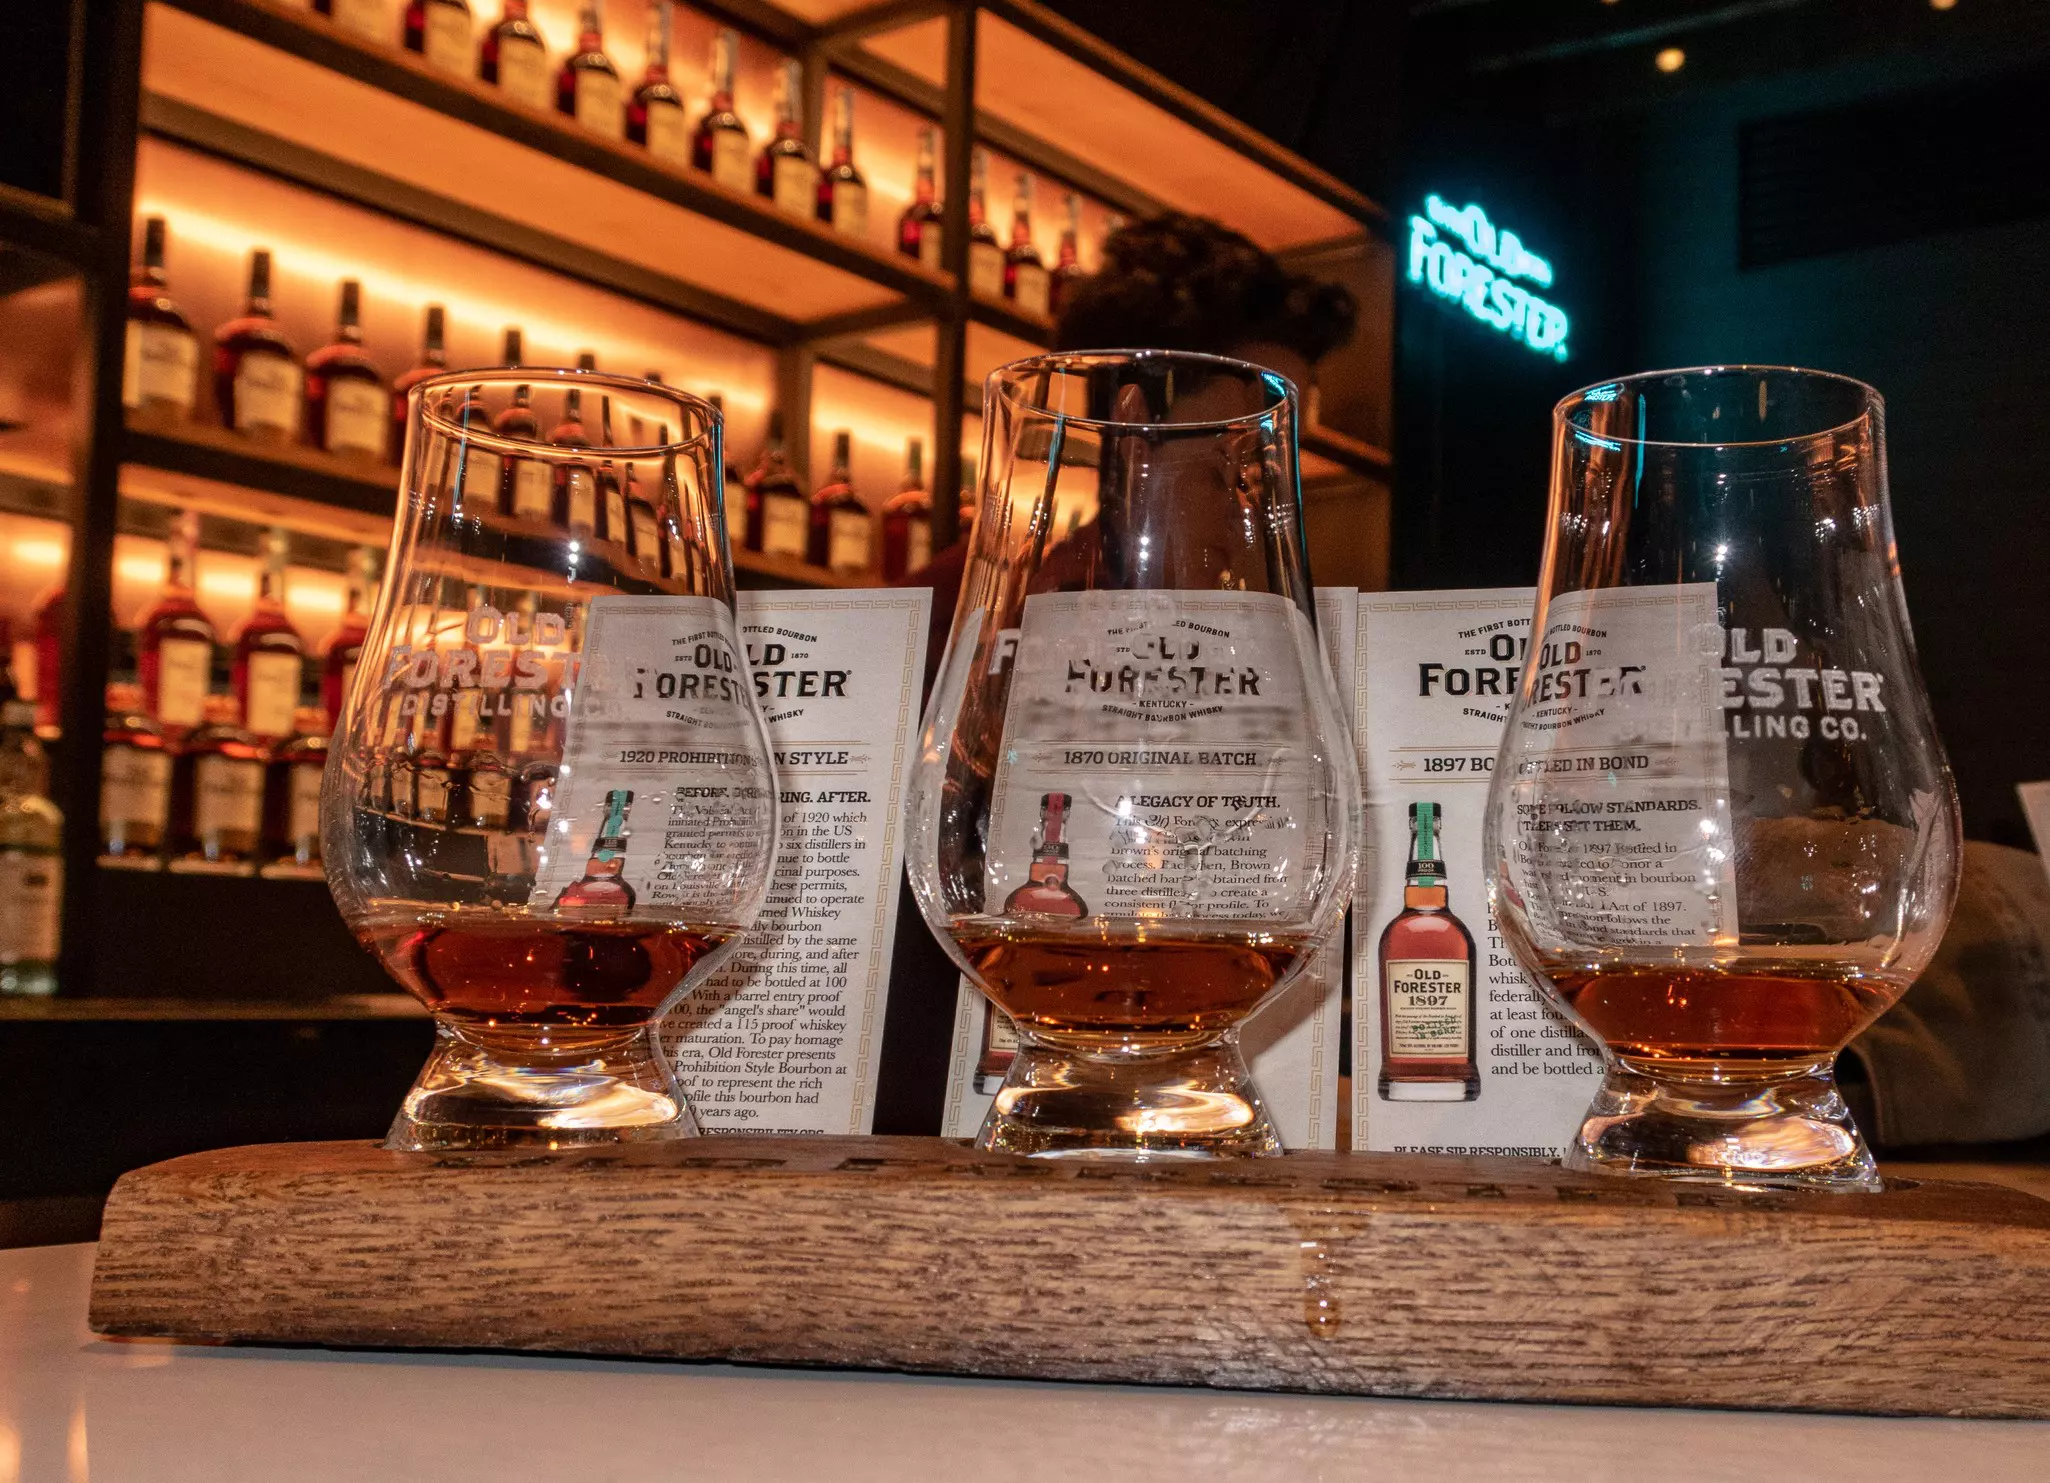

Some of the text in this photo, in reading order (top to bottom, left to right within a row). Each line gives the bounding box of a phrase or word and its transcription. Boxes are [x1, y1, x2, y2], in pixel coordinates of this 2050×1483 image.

[466, 606, 565, 646] OLD
[1188, 621, 1231, 638] BOURBON
[1458, 621, 1505, 640] THE FIRST
[1572, 625, 1608, 639] BOURBON
[776, 628, 818, 643] BOURBON
[694, 643, 733, 673] OLD
[748, 643, 809, 666] LD 1870
[1539, 641, 1581, 671] OLD
[381, 644, 582, 690] FOREST
[1418, 662, 1521, 697] FORE
[1138, 700, 1188, 709] KENTUCKY
[769, 709, 805, 723] WHISKY
[1102, 704, 1143, 721] STRAIGHT
[1189, 705, 1224, 719] WHISKY
[1733, 715, 1868, 741] LING CO.
[620, 751, 656, 764] 1920
[789, 751, 849, 765] STYLE
[1063, 751, 1257, 766] 1870 ORIGINAL BATCH
[1423, 757, 1466, 772] 1897
[1576, 755, 1649, 771] IN BOND
[817, 791, 872, 803] AFTER.
[1130, 795, 1193, 808] LEGACY
[1196, 795, 1218, 808] OF
[1606, 799, 1703, 814] STANDARDS.
[784, 812, 867, 823] of 1920 which
[797, 826, 808, 836] in
[812, 825, 830, 836] the
[834, 825, 853, 836] US
[786, 839, 866, 850] six distillers in
[1664, 842, 1678, 853] in
[802, 853, 814, 863] to
[817, 852, 850, 863] bottle
[1230, 860, 1271, 871] Brown
[805, 867, 860, 880] purposes.
[1640, 872, 1697, 884] bourbon
[800, 880, 848, 894] permits,
[1106, 886, 1258, 897] three create
[806, 894, 864, 907] to operate
[1104, 899, 1270, 911] consistent profile. To
[1633, 901, 1687, 912] of 1897.
[792, 906, 842, 921] Whiskey
[1651, 915, 1671, 925] the
[771, 920, 822, 932] bourbon
[1671, 927, 1697, 936] that
[787, 934, 857, 949] by the same
[760, 948, 860, 962] during, and after
[731, 962, 848, 976] During this time, all
[1414, 968, 1442, 980] OLD
[705, 976, 847, 988] had to be bottled at 100
[1394, 980, 1461, 993] FORESTER
[692, 989, 843, 1006] With a barrel entry proof
[1408, 995, 1448, 1006] 1897
[696, 1003, 846, 1018] the "angel's share" would
[1489, 1008, 1537, 1020] at least
[678, 1018, 847, 1034] created a 115 proof whiskey
[1490, 1025, 1537, 1039] of one
[675, 1033, 745, 1045] maturation.
[749, 1032, 766, 1045] To
[768, 1036, 791, 1047] pay
[794, 1033, 843, 1048] homage
[681, 1046, 836, 1062] era, Old Forester presents
[1490, 1043, 1572, 1057] distiller and
[674, 1060, 848, 1076] Prohibition Style Bourbon at
[1491, 1061, 1593, 1075] and be bottled
[701, 1077, 823, 1092] to represent the rich
[714, 1090, 820, 1104] this bourbon had
[700, 1107, 760, 1120] years ago.
[1468, 1146, 1561, 1158] RESPONSIBLY.
